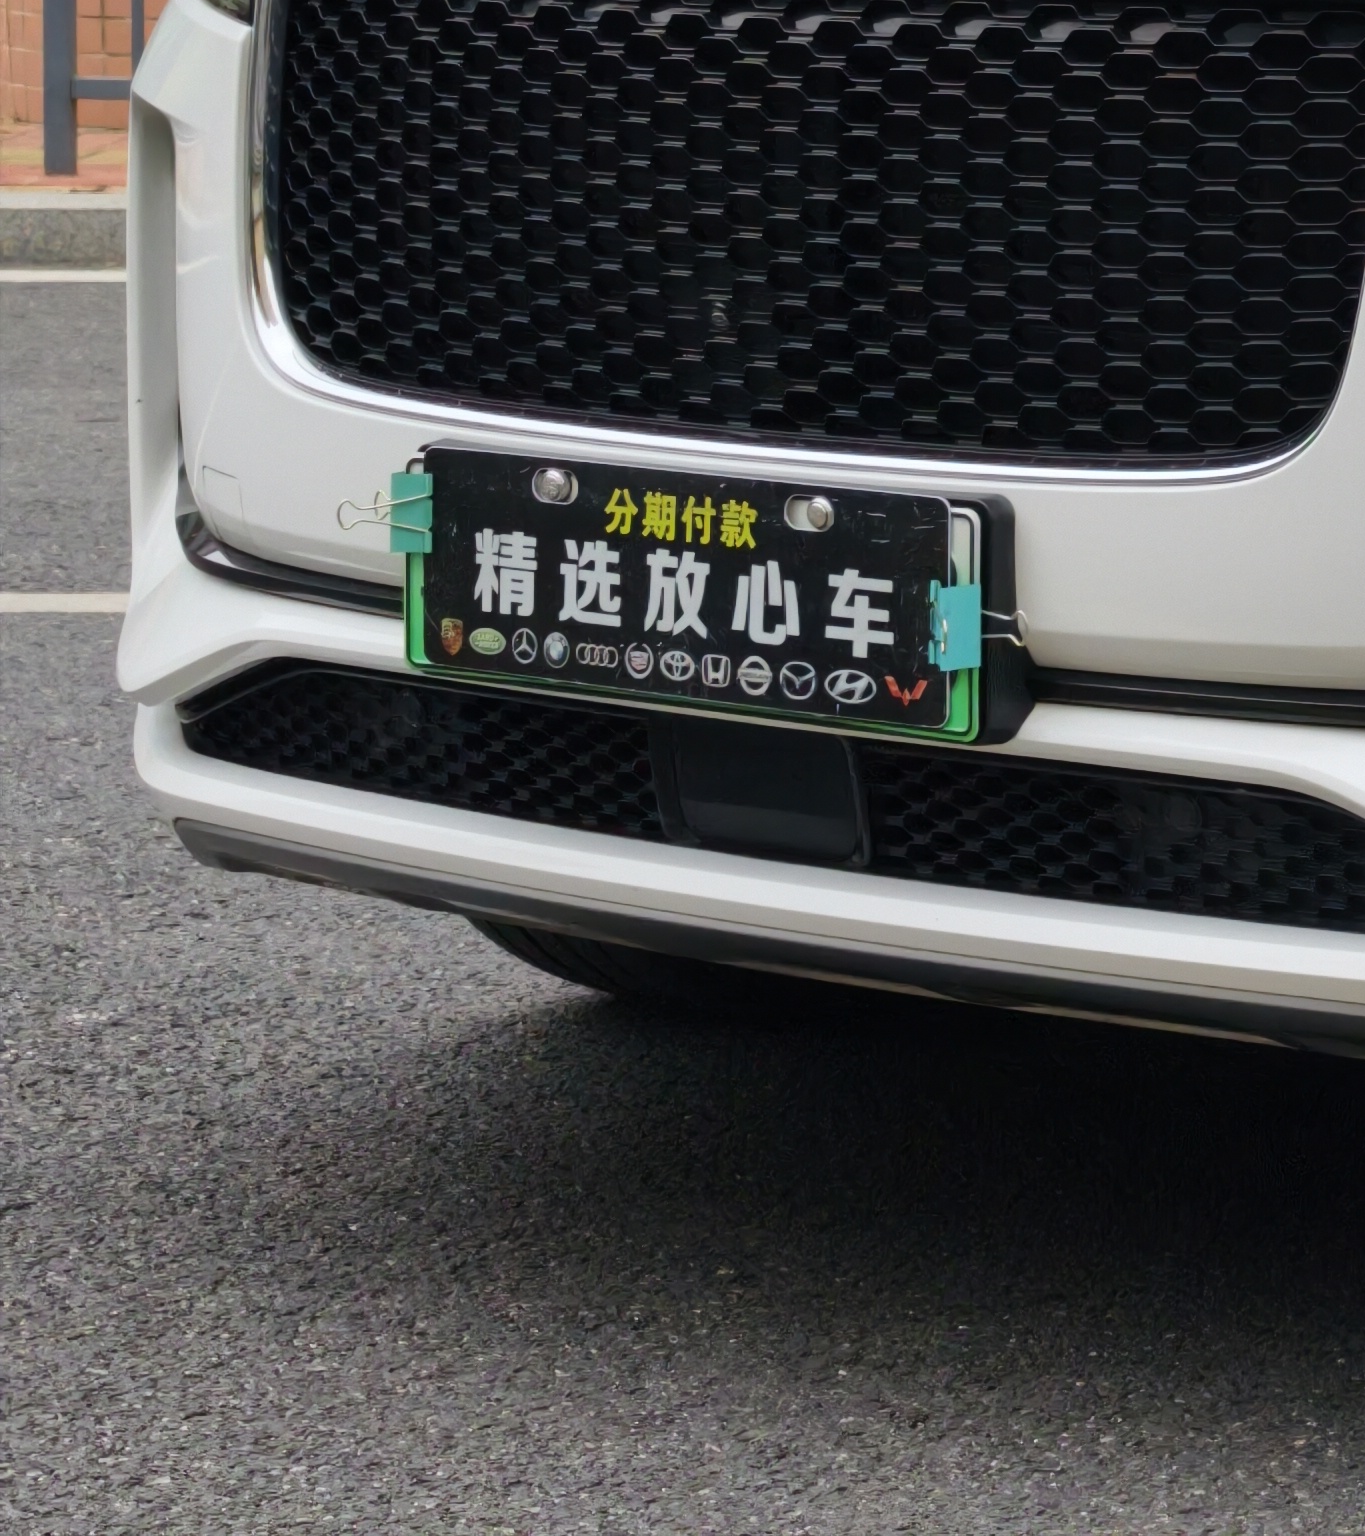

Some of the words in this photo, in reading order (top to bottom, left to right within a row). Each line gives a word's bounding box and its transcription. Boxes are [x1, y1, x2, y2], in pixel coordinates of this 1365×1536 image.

[604, 487, 759, 551] 分期付款
[473, 526, 897, 660] 精选放心车
